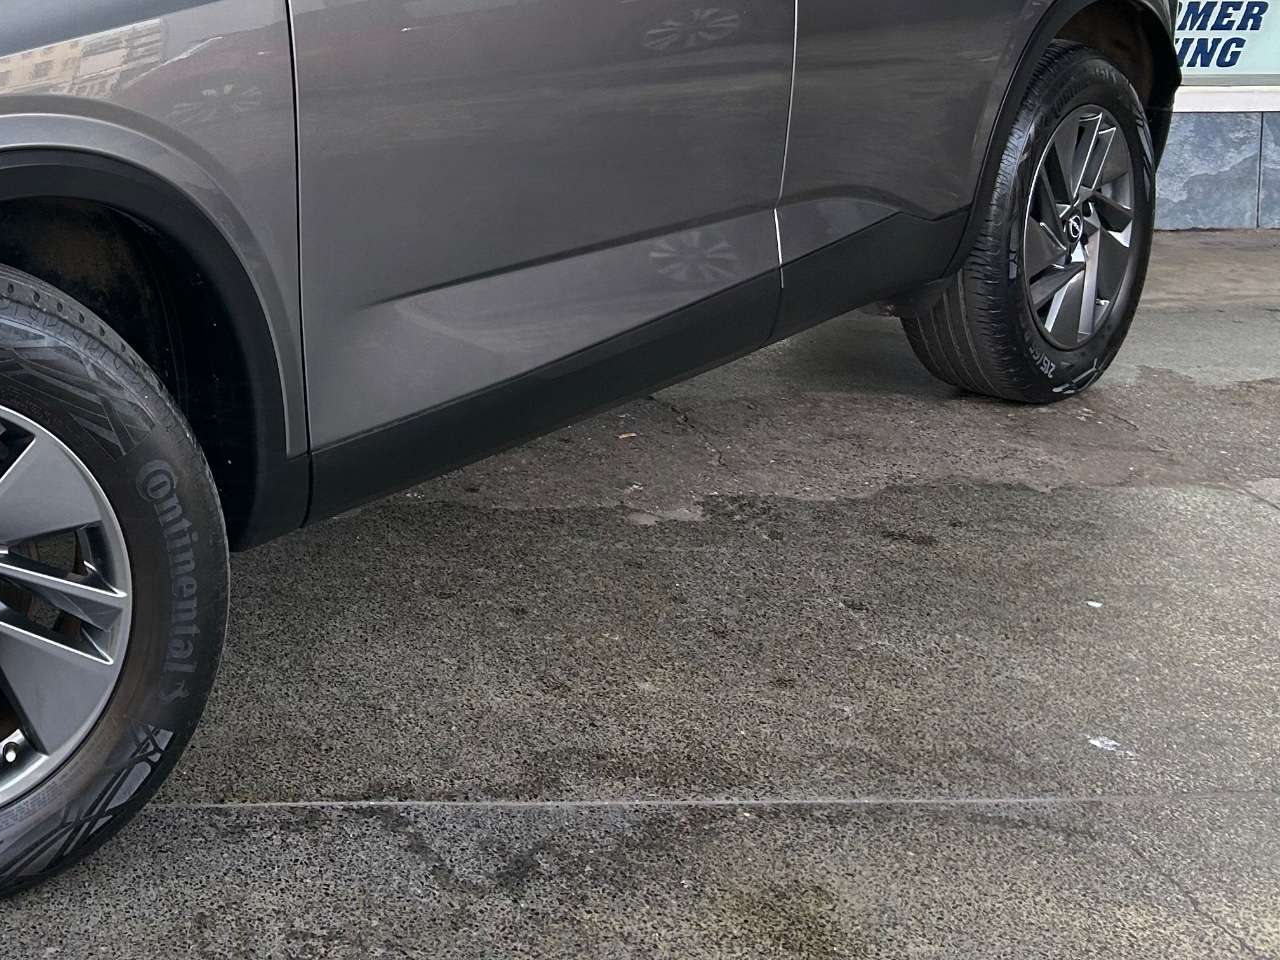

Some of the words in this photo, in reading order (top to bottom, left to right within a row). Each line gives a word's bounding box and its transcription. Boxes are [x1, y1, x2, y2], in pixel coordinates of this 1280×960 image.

[1177, 0, 1269, 31] MER
[1175, 37, 1247, 68] ING
[136, 459, 201, 673] Continental
